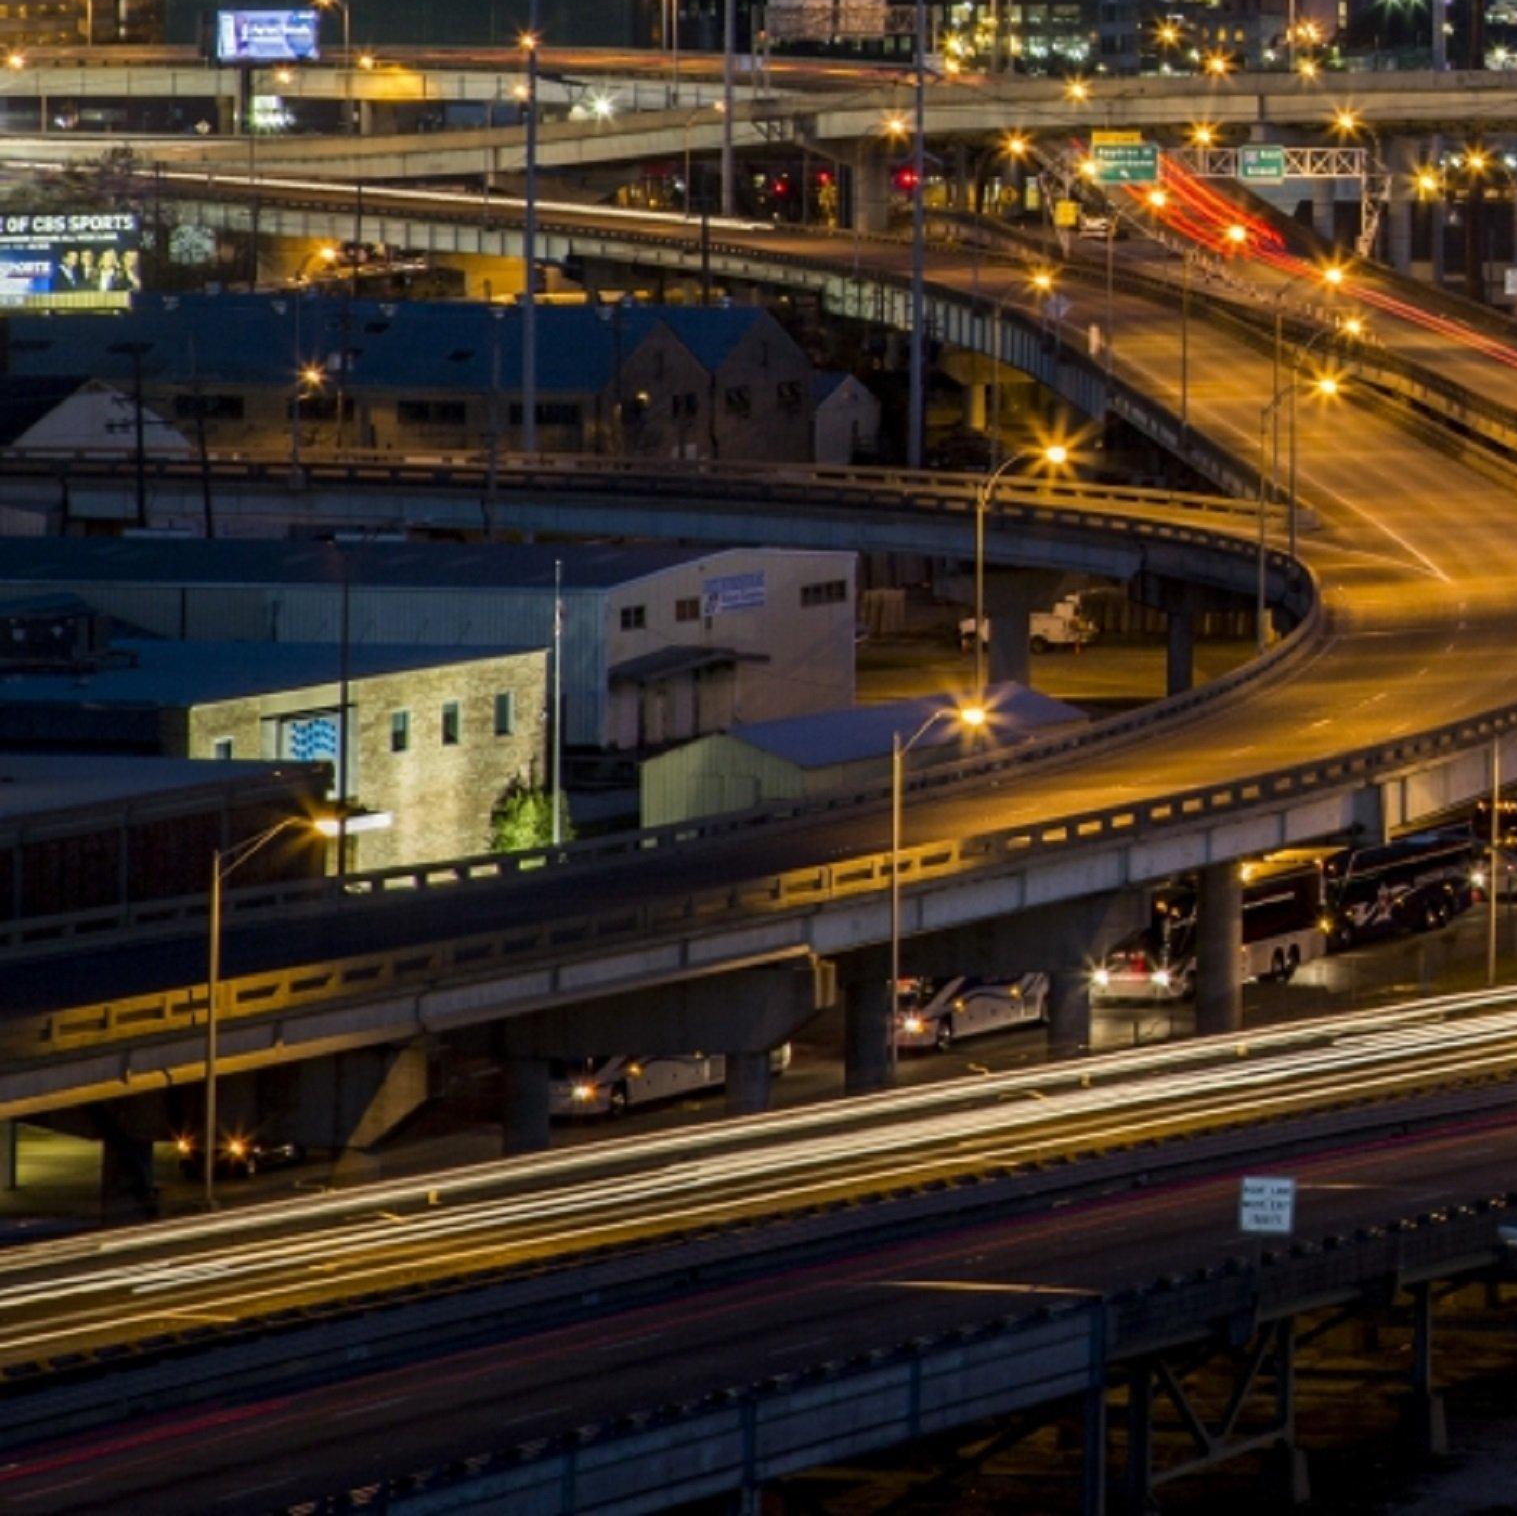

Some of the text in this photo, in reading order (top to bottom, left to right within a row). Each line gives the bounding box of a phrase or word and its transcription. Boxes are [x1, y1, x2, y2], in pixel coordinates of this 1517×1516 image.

[6, 216, 29, 232] OF
[33, 216, 65, 232] CBS
[68, 214, 134, 230] SPORTS
